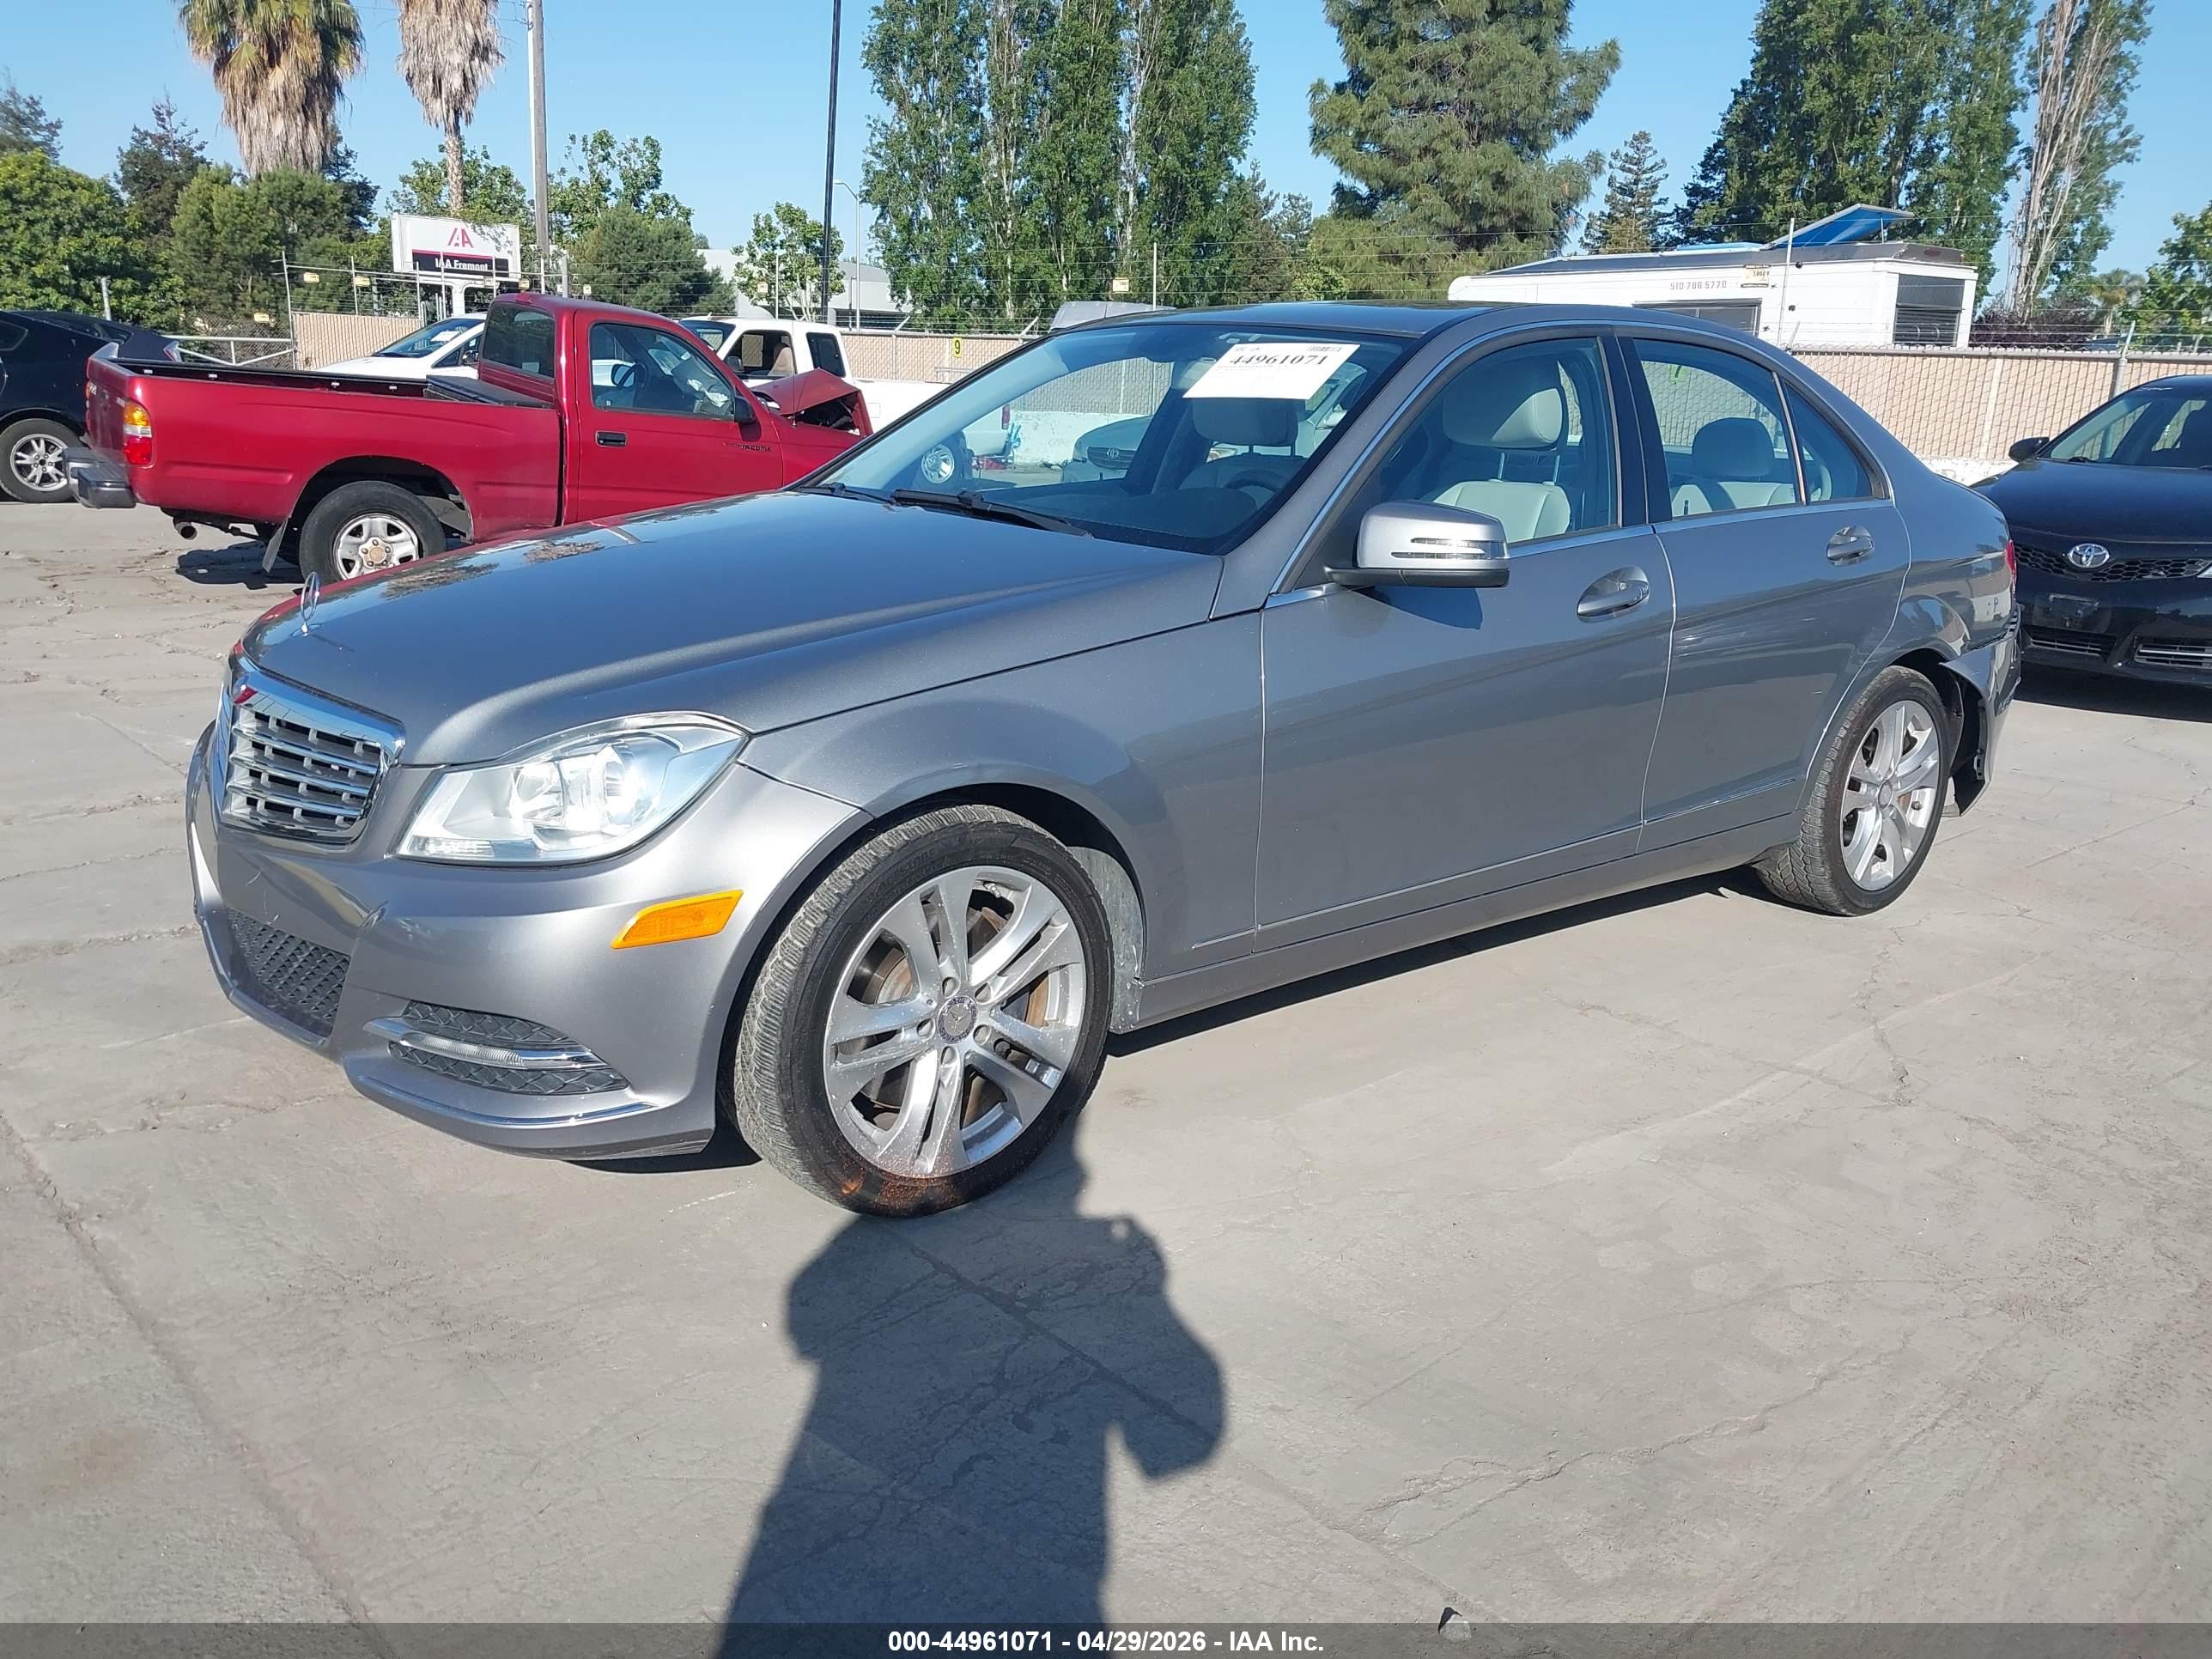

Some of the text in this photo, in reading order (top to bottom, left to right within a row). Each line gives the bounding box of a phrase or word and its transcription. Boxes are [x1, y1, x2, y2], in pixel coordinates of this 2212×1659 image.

[453, 259, 489, 271] Fremont
[954, 339, 961, 355] 9
[1230, 355, 1328, 365] 44961071
